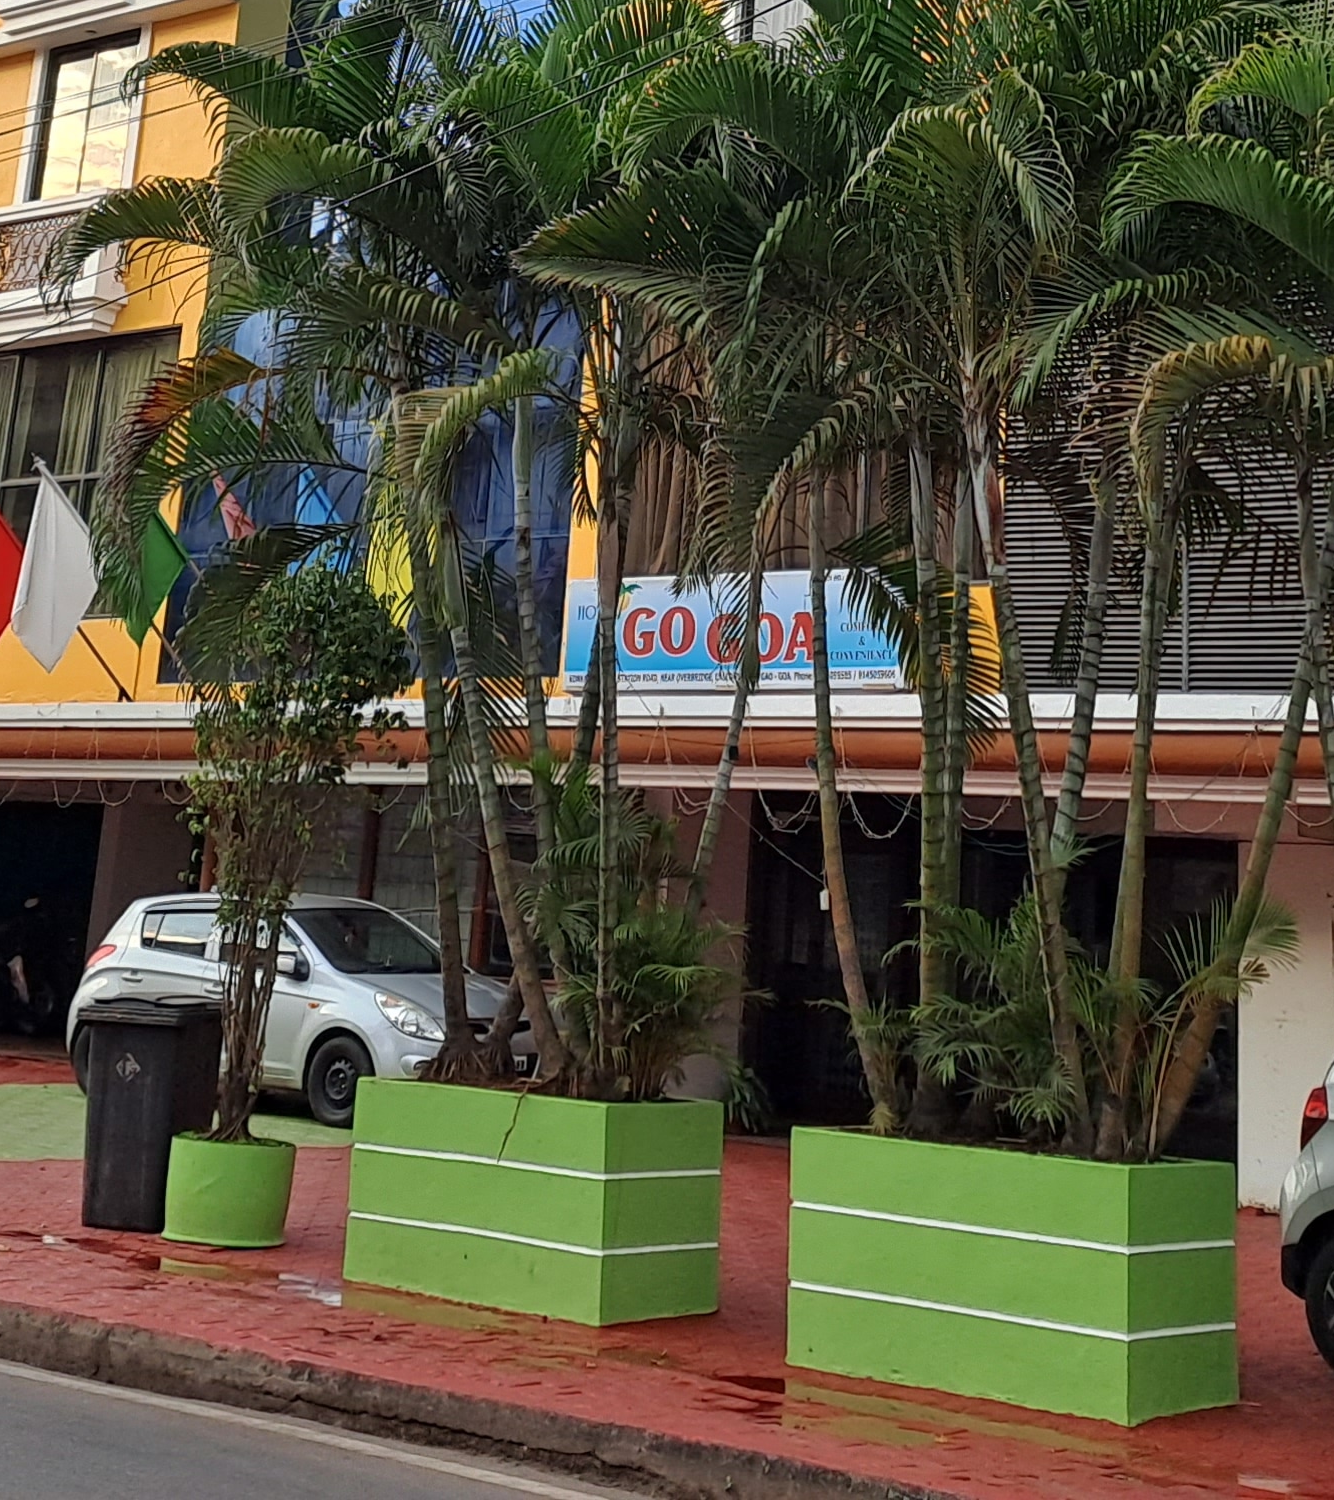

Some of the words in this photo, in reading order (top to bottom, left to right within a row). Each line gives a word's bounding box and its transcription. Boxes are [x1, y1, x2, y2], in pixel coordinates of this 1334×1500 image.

[622, 606, 696, 657] GO
[706, 612, 814, 664] GOA
[858, 636, 866, 646] &
[830, 650, 894, 661] CONVENIENCE
